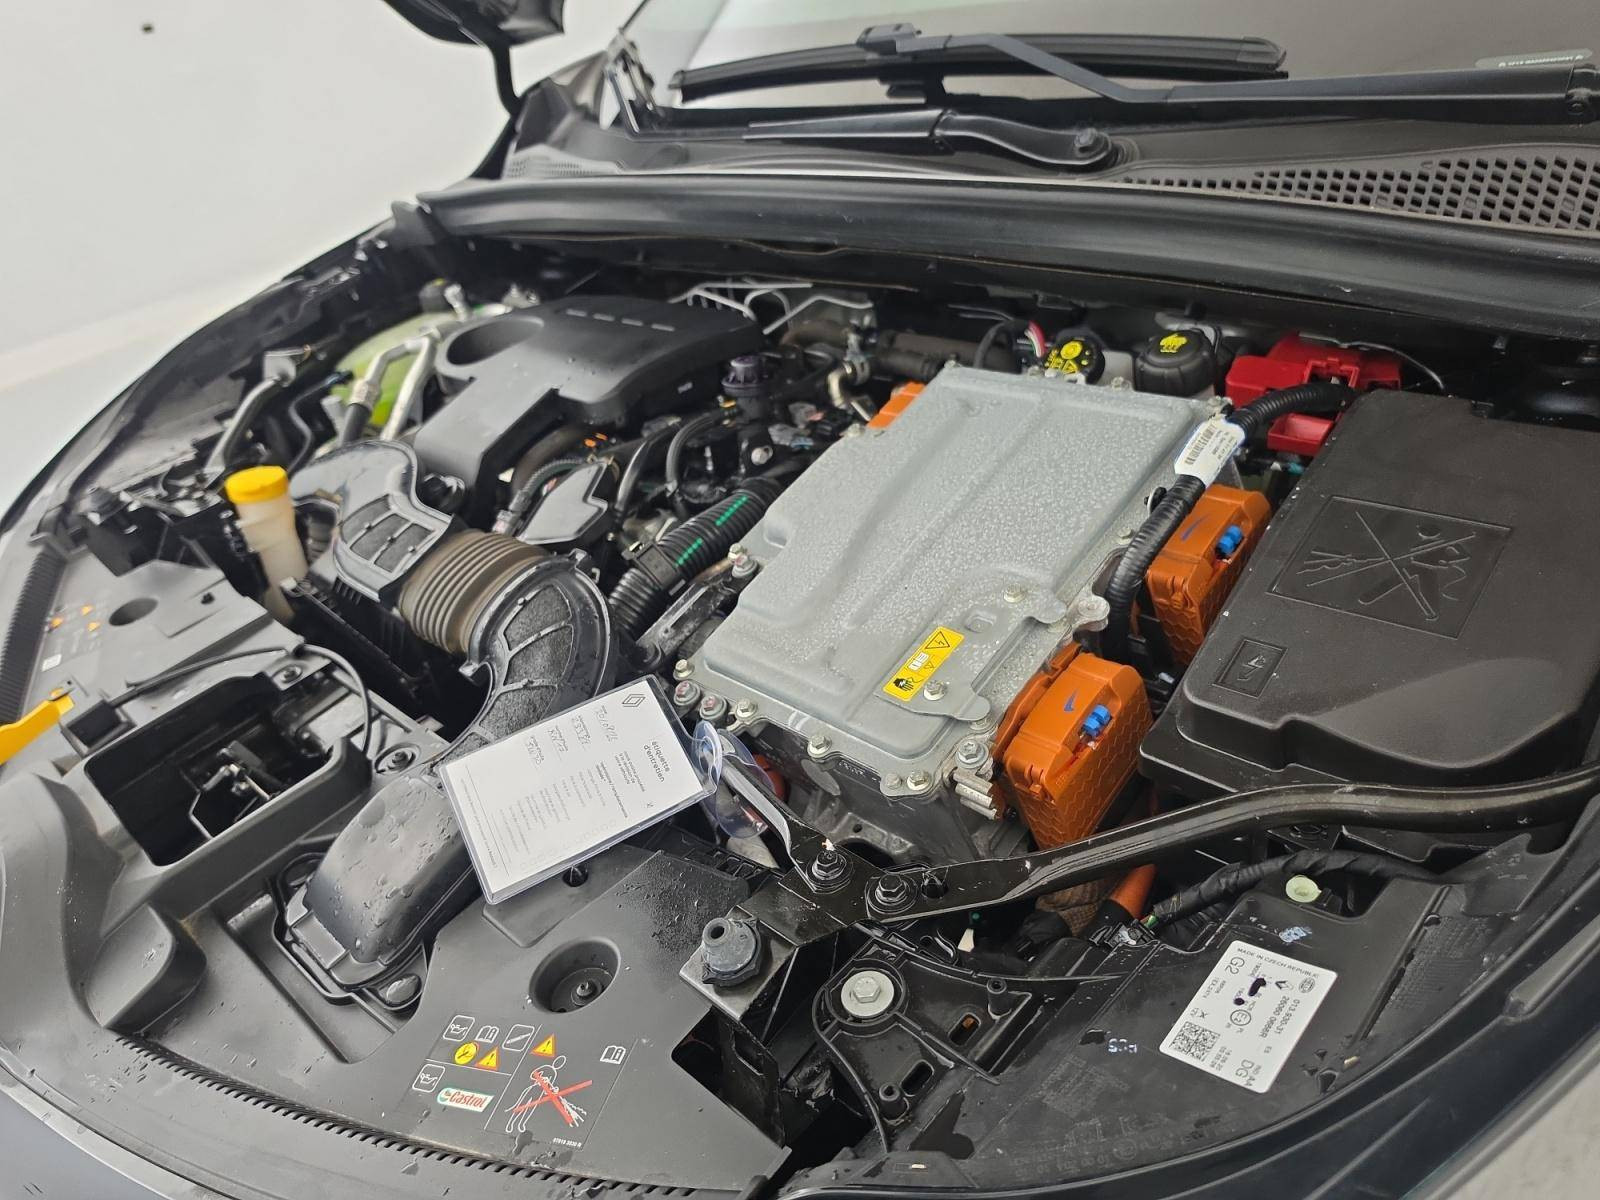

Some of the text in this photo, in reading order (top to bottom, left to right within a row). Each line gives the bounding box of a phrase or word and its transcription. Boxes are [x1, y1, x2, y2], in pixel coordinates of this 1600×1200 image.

[644, 744, 665, 782] d'entretien
[1225, 956, 1245, 975] G2
[1237, 948, 1255, 957] MADE
[1264, 957, 1287, 967] CZECH
[1235, 1058, 1254, 1078] DG
[449, 1091, 487, 1108] Castrol
